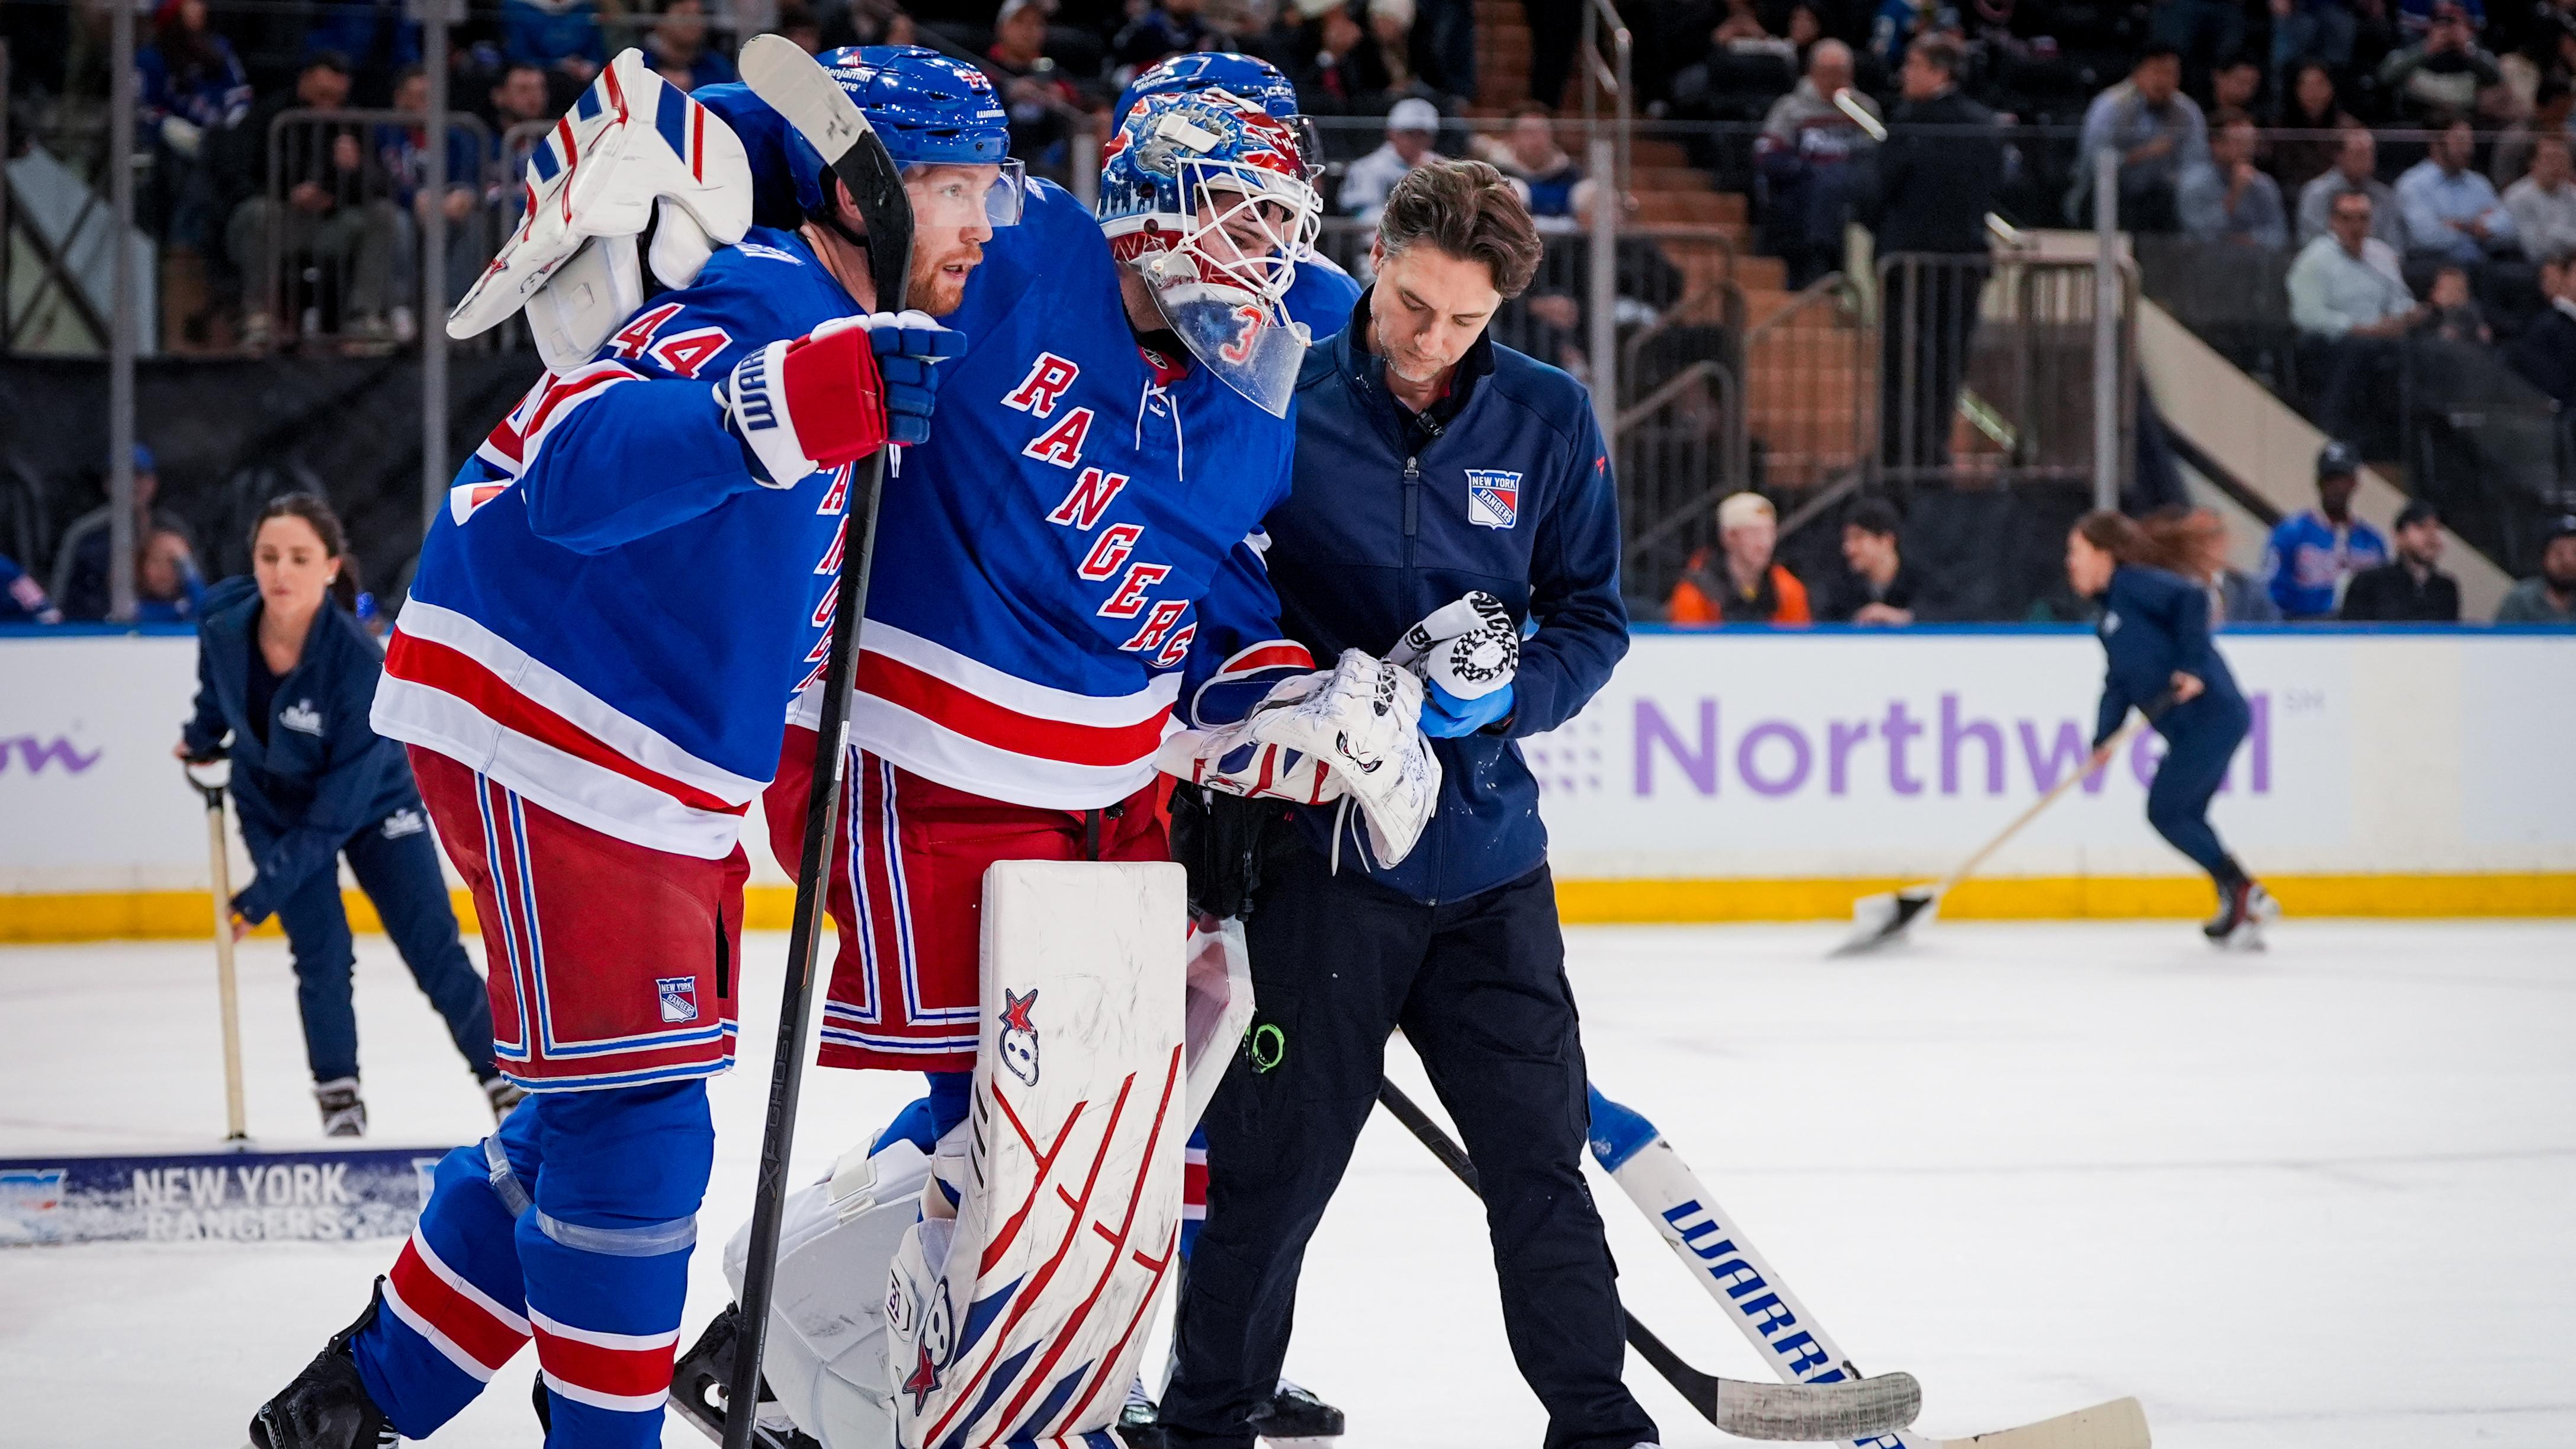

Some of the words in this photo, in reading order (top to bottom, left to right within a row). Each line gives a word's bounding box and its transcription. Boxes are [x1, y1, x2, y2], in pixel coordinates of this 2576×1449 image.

[835, 81, 858, 92] ore
[1267, 86, 1292, 97] CCM
[607, 302, 733, 380] 44
[1472, 476, 1492, 486] NEW
[1494, 477, 1515, 489] YORK
[1000, 352, 1197, 668] RANGERS
[1479, 489, 1513, 523] RANGERS
[1634, 693, 2271, 797] Northwel
[661, 984, 675, 992] NEW
[676, 982, 692, 991] YORK
[667, 994, 695, 1016] RANGERS
[132, 1165, 229, 1207] NEW
[237, 1162, 351, 1205] YORK
[146, 1206, 345, 1241] RANGERS
